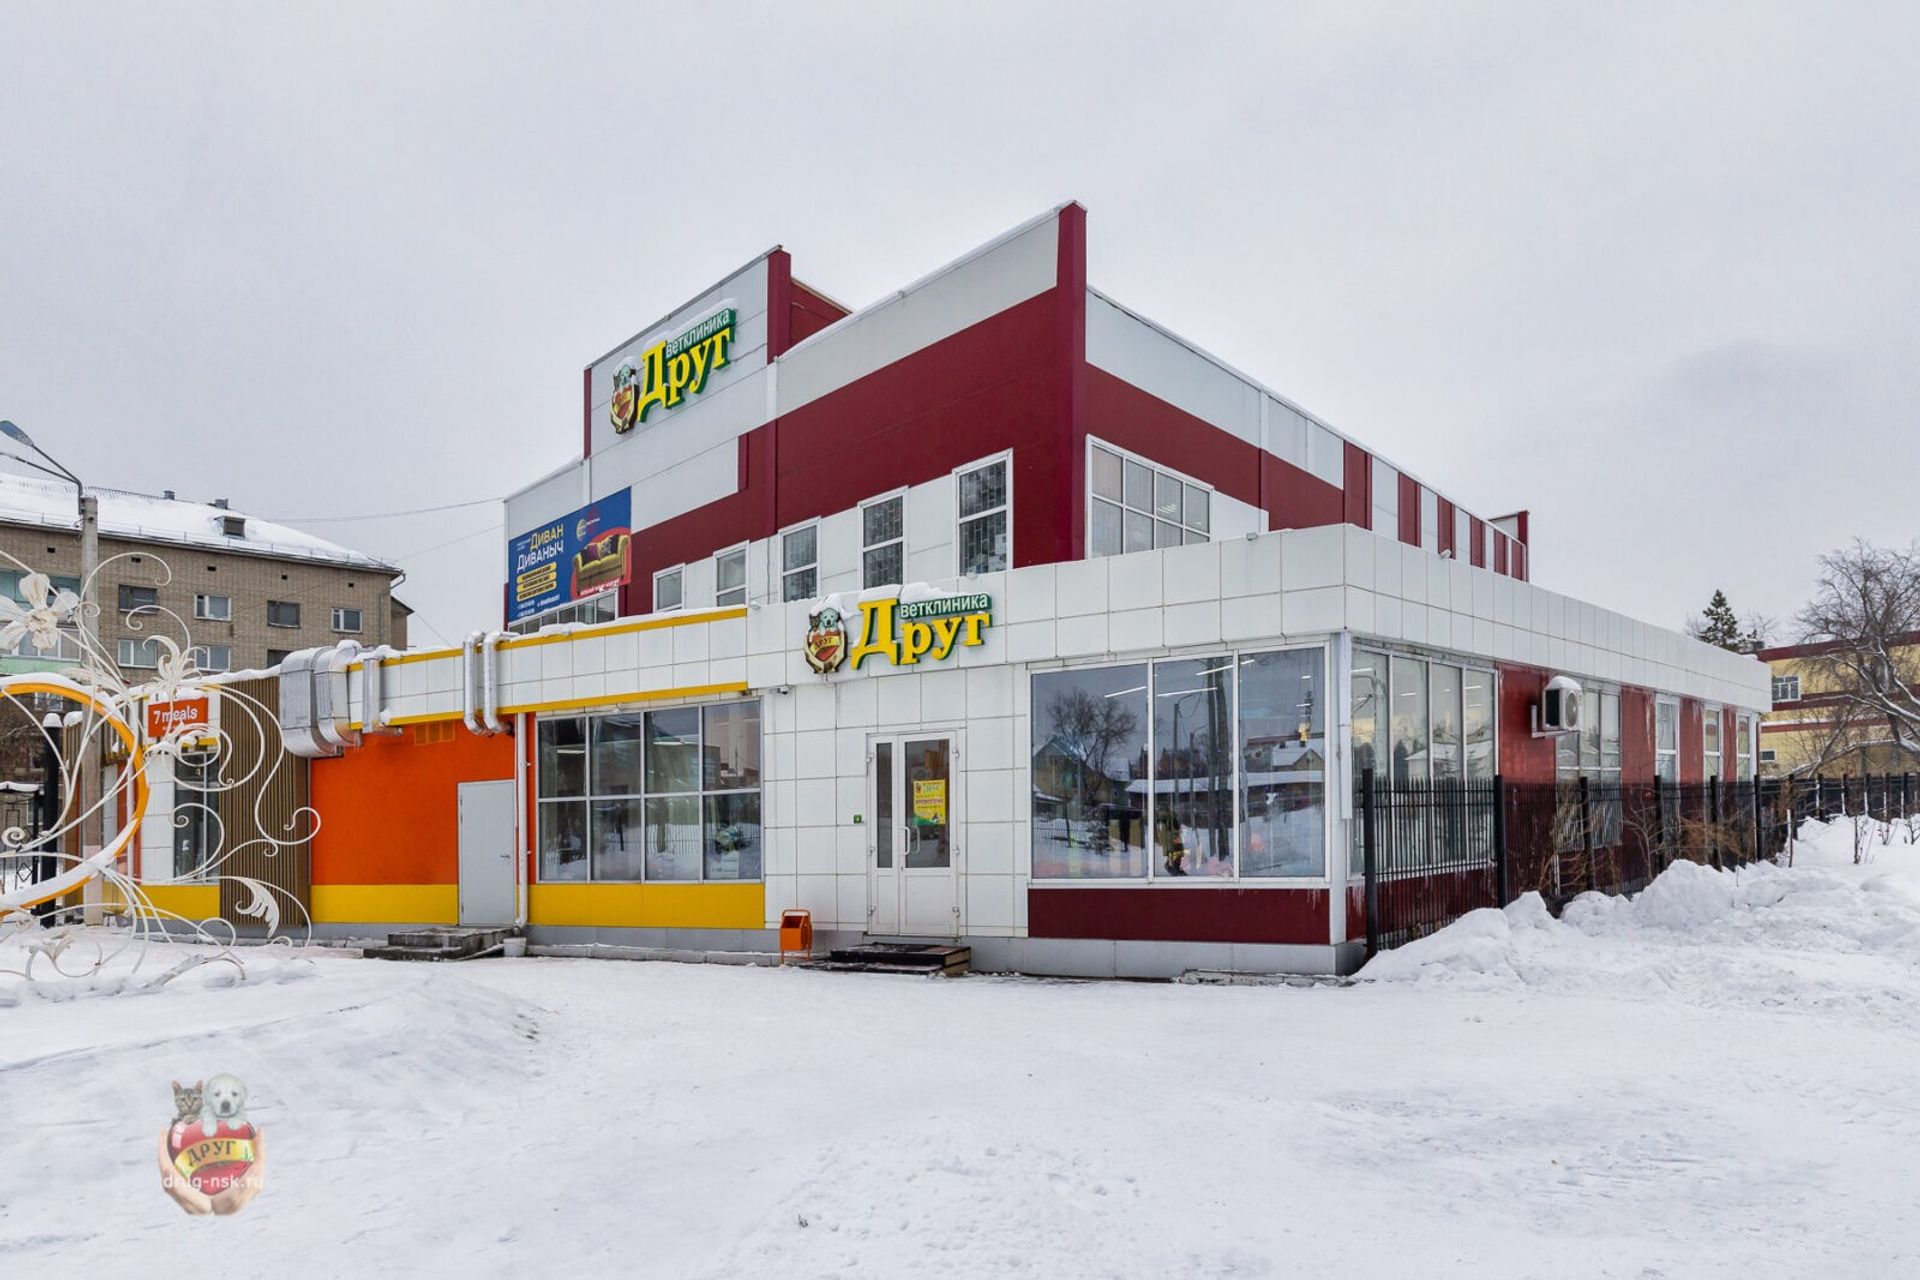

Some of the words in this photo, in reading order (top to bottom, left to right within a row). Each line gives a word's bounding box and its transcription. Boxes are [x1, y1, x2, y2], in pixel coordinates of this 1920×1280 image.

[665, 309, 729, 359] ветклиника
[637, 328, 731, 422] Друг
[851, 598, 990, 670] Друг
[900, 594, 988, 619] ветклиника
